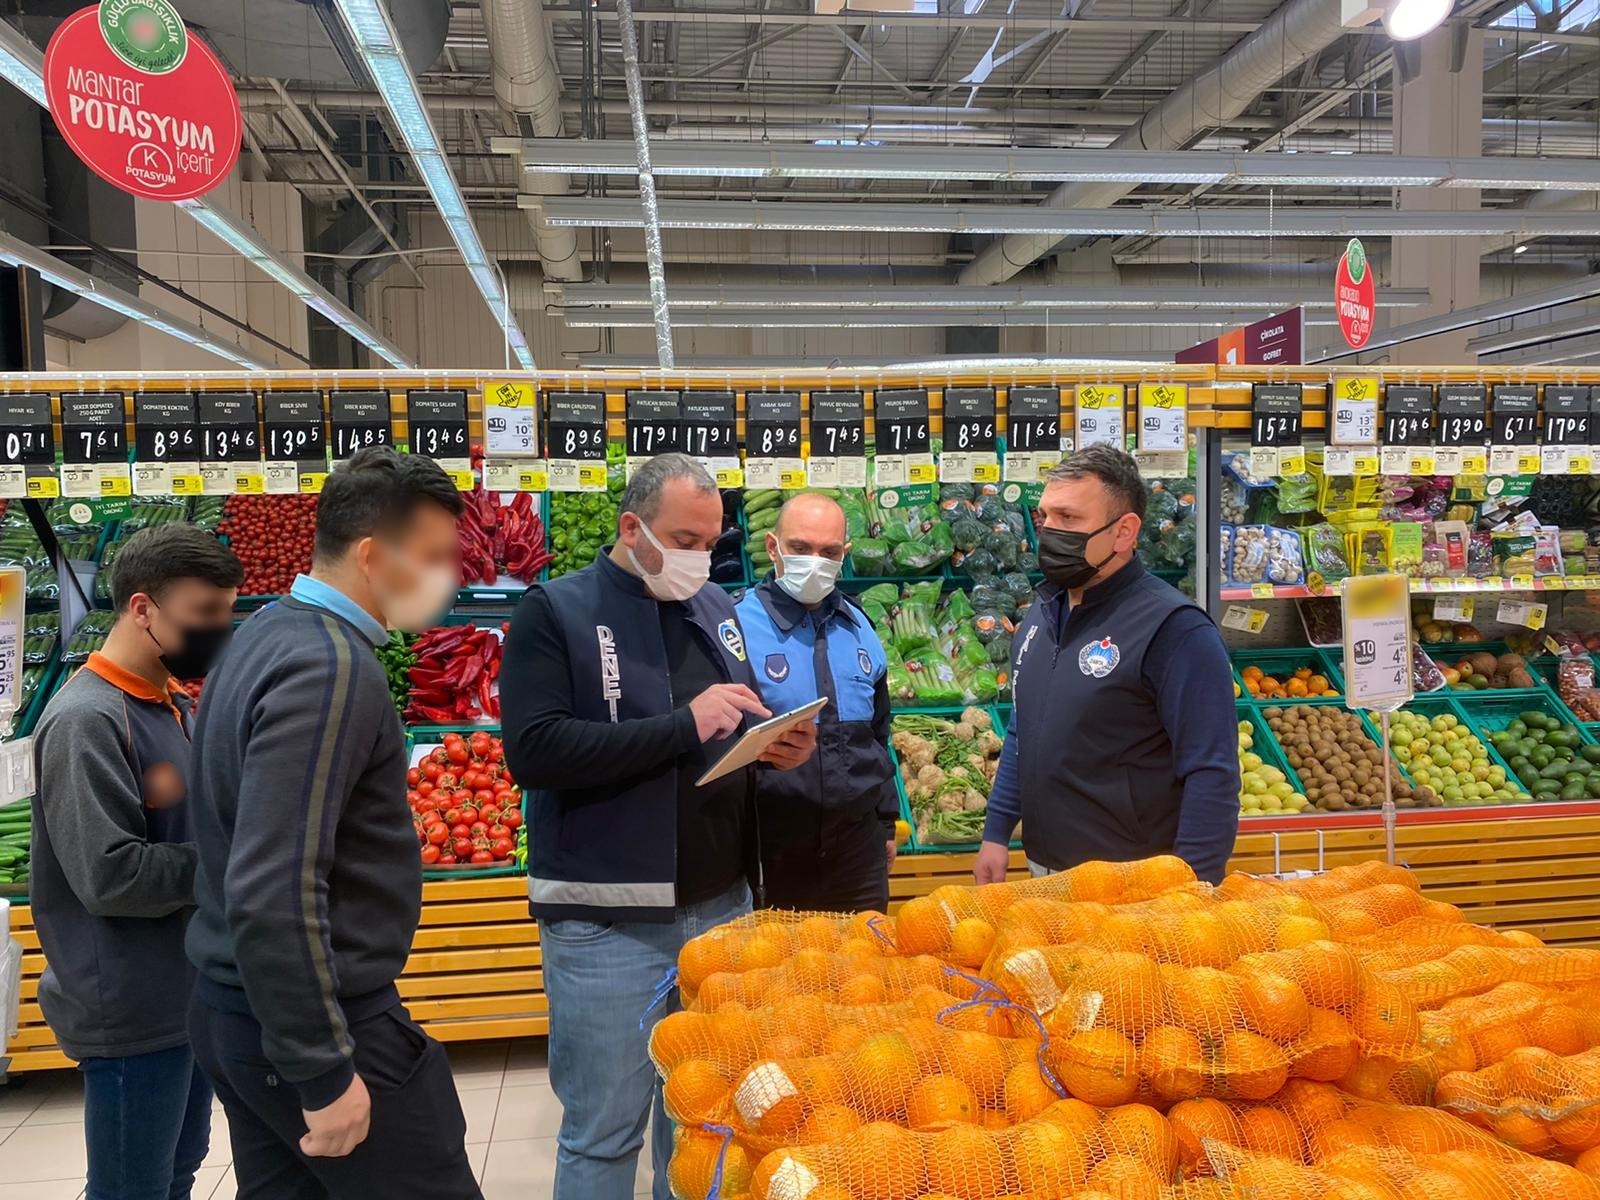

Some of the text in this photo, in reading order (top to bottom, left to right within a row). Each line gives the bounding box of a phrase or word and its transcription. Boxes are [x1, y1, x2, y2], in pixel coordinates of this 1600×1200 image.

[69, 93, 215, 154] POTASYUM
[144, 148, 158, 168] K
[176, 146, 214, 175] içerir
[126, 166, 176, 184] POTASYUM
[1340, 300, 1370, 322] POTASYUM
[1260, 325, 1284, 342] ÇİKOLATA
[1262, 348, 1282, 361] GOFRET
